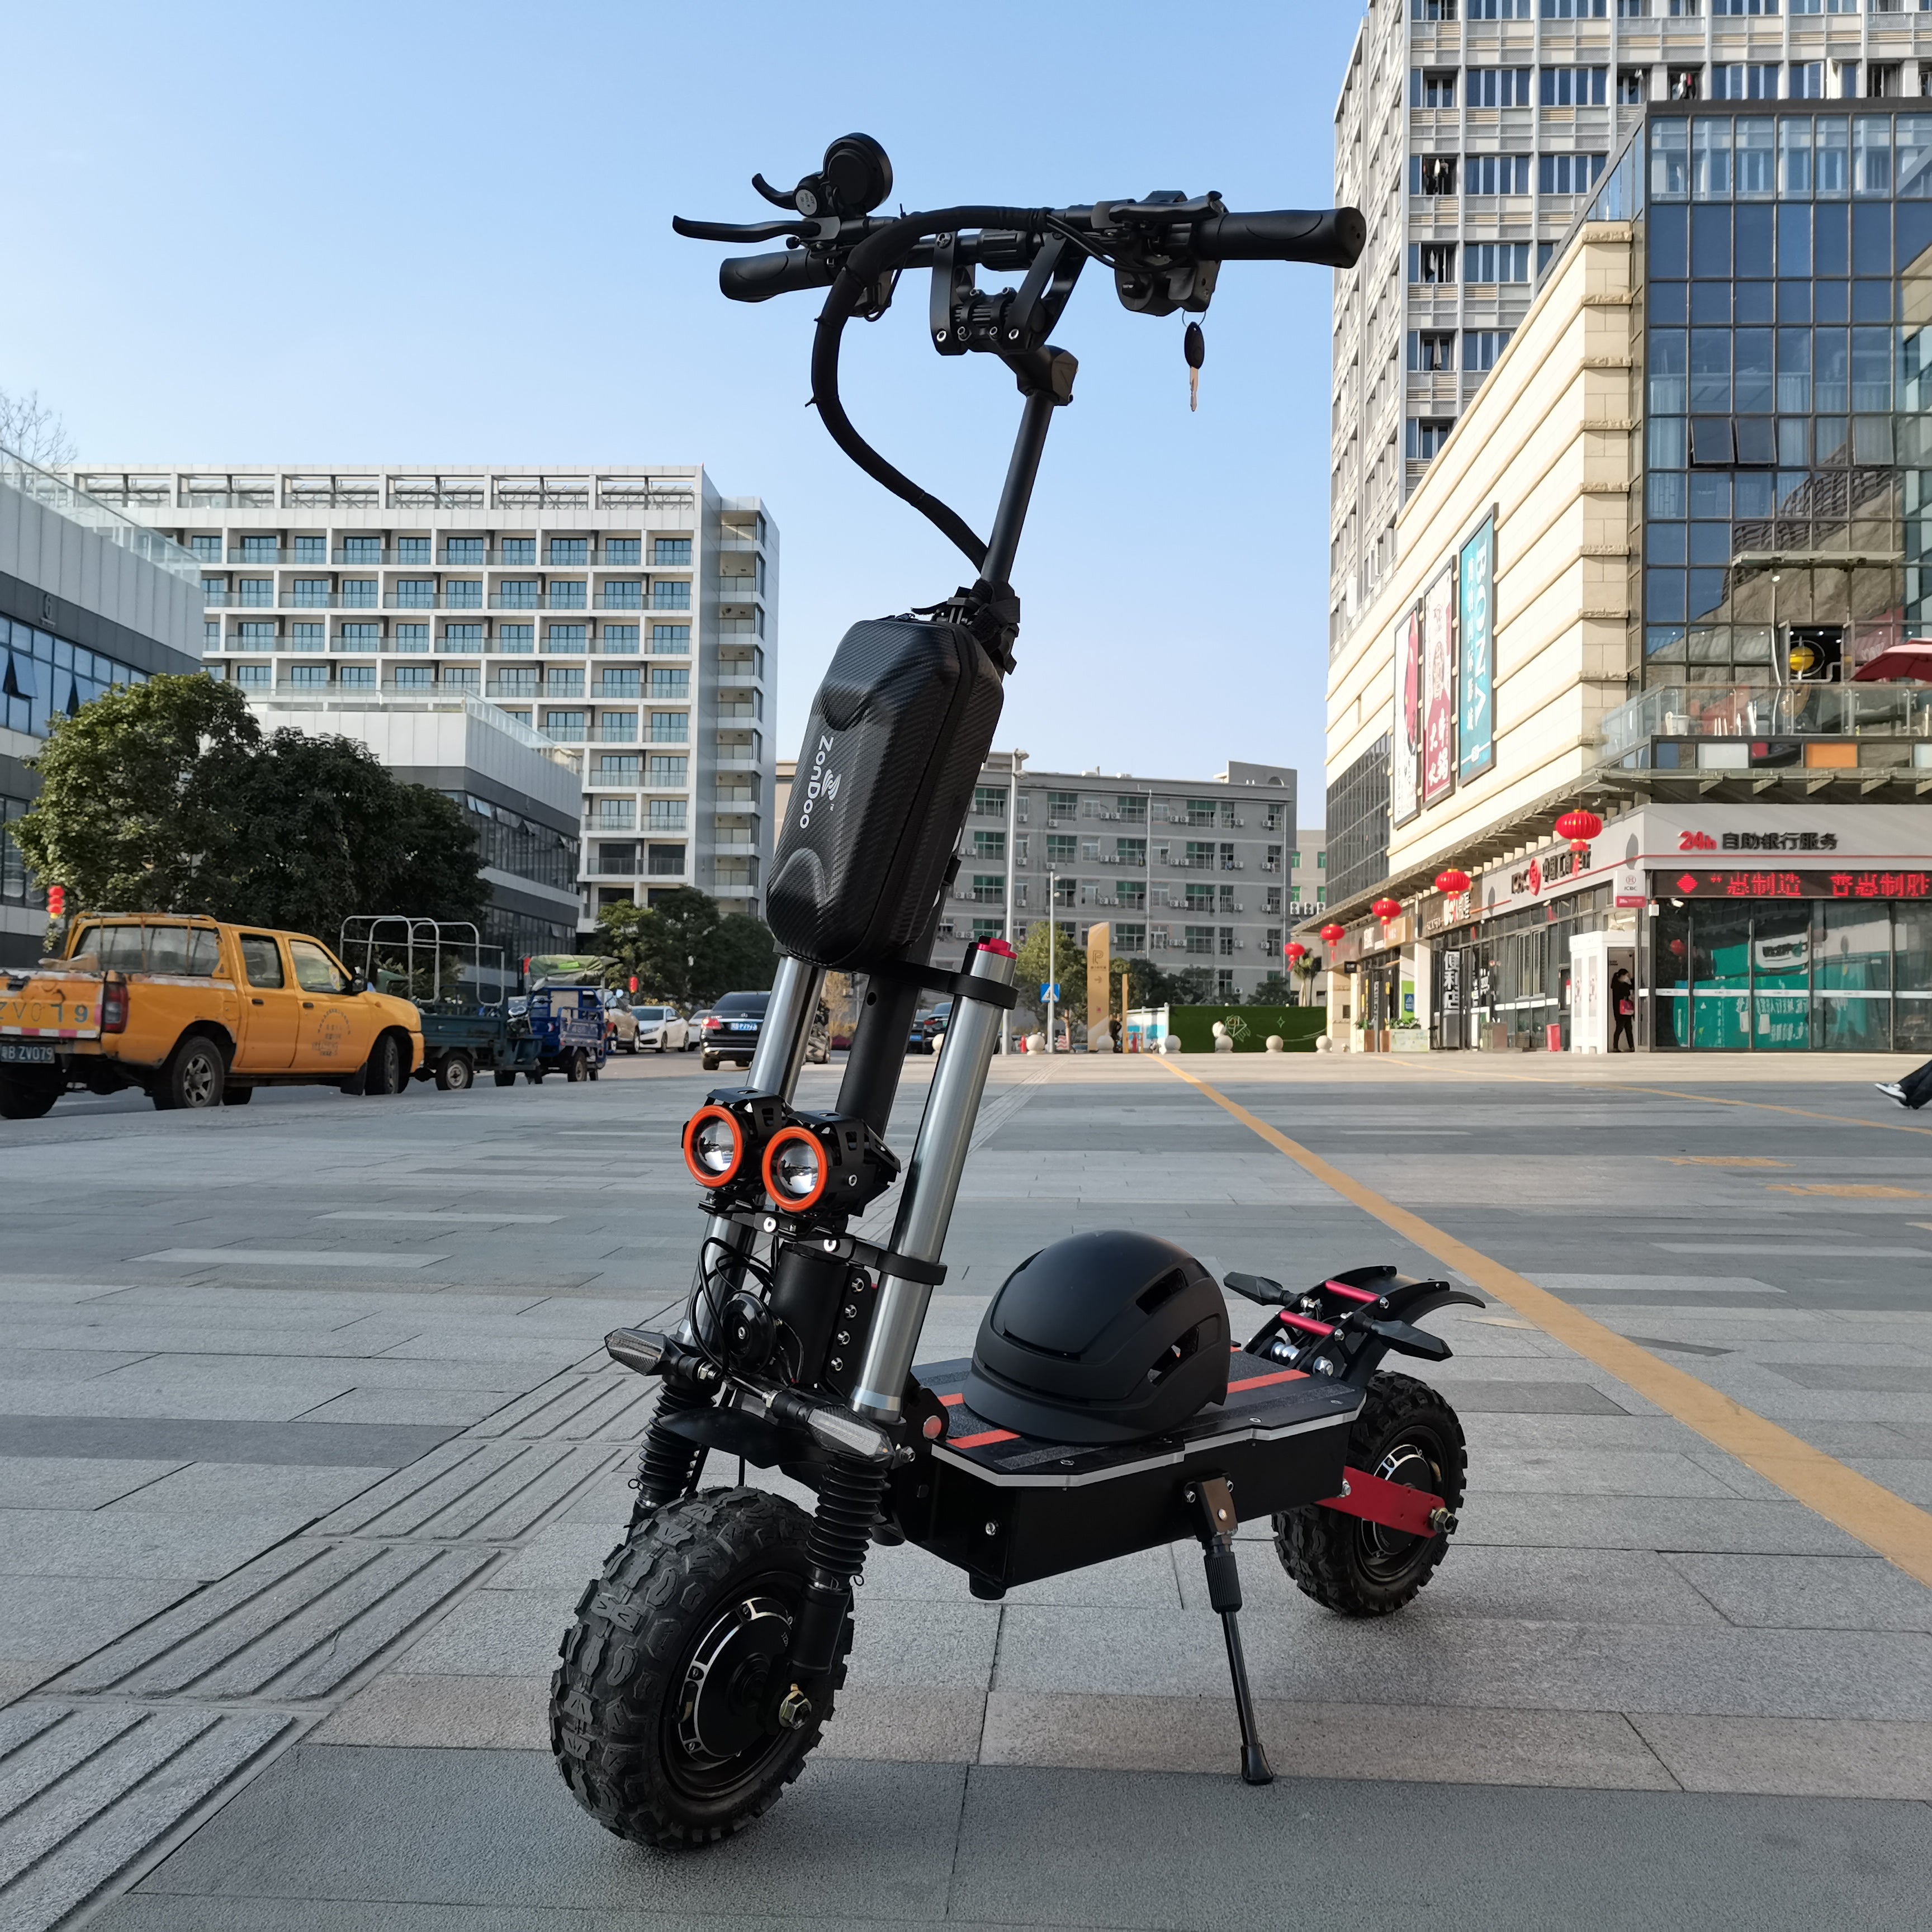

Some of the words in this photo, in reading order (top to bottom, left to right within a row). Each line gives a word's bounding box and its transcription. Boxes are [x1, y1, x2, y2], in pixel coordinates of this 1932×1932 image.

[1475, 538, 1487, 727] BONA
[800, 735, 834, 828] ZonDoo
[1678, 831, 1717, 850] 24h
[1722, 832, 1838, 850] 自助银行服务
[1443, 950, 1460, 1010] 便利店
